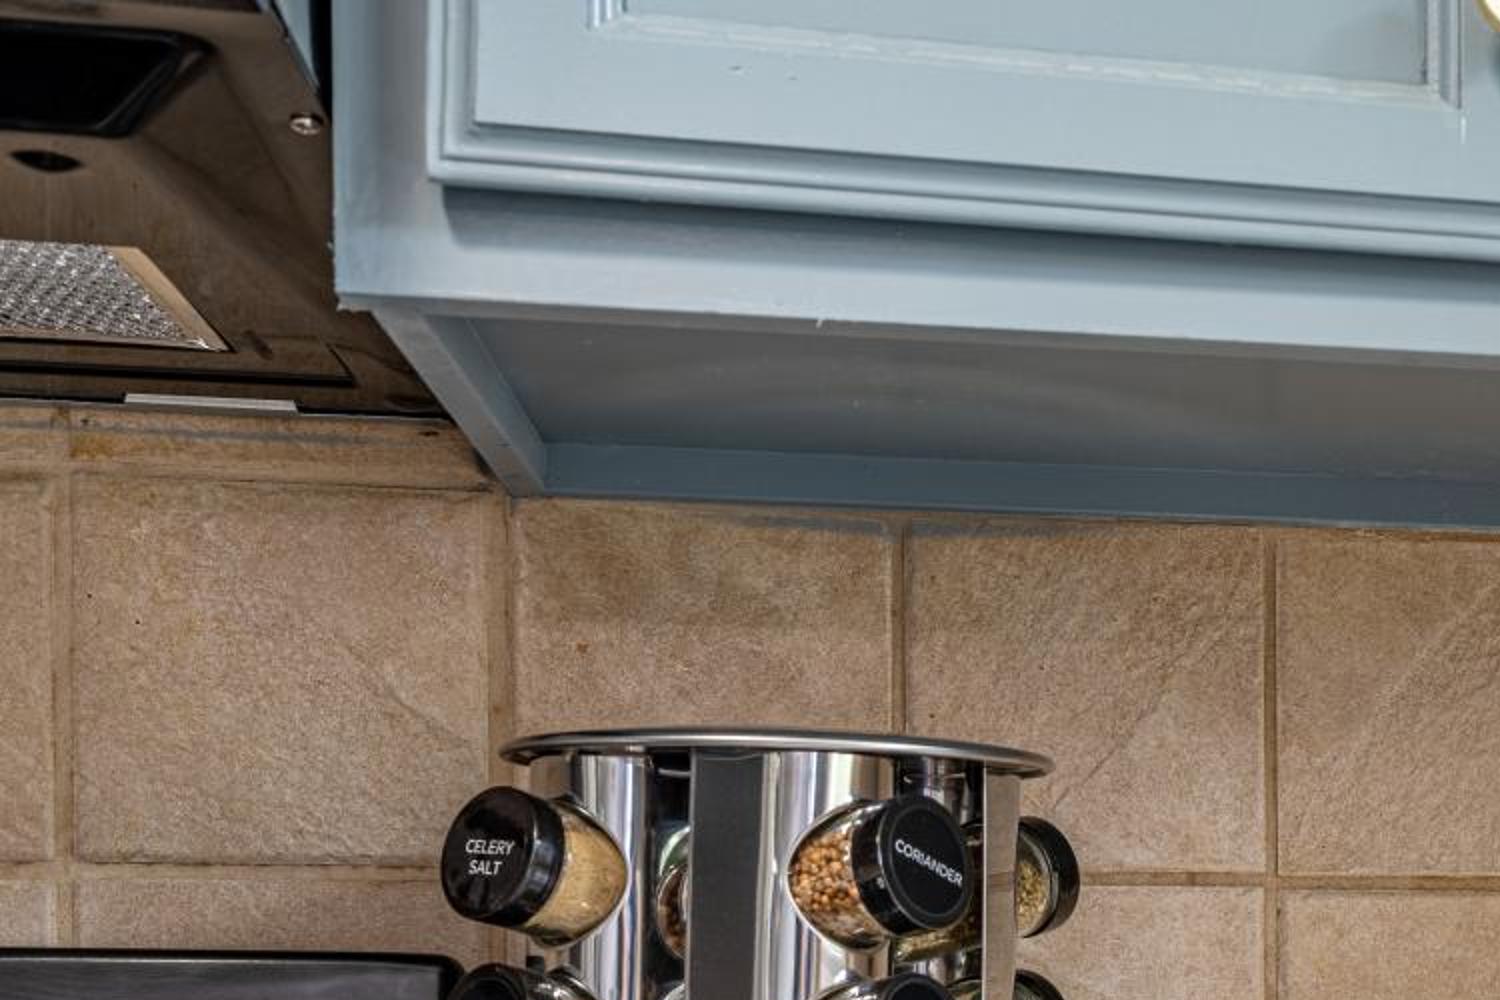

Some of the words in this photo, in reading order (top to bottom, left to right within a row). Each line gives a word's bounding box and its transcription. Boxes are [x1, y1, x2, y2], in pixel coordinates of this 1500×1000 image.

[465, 838, 516, 857] CELERY
[468, 859, 503, 876] SALT
[895, 839, 963, 888] CORIANDER
